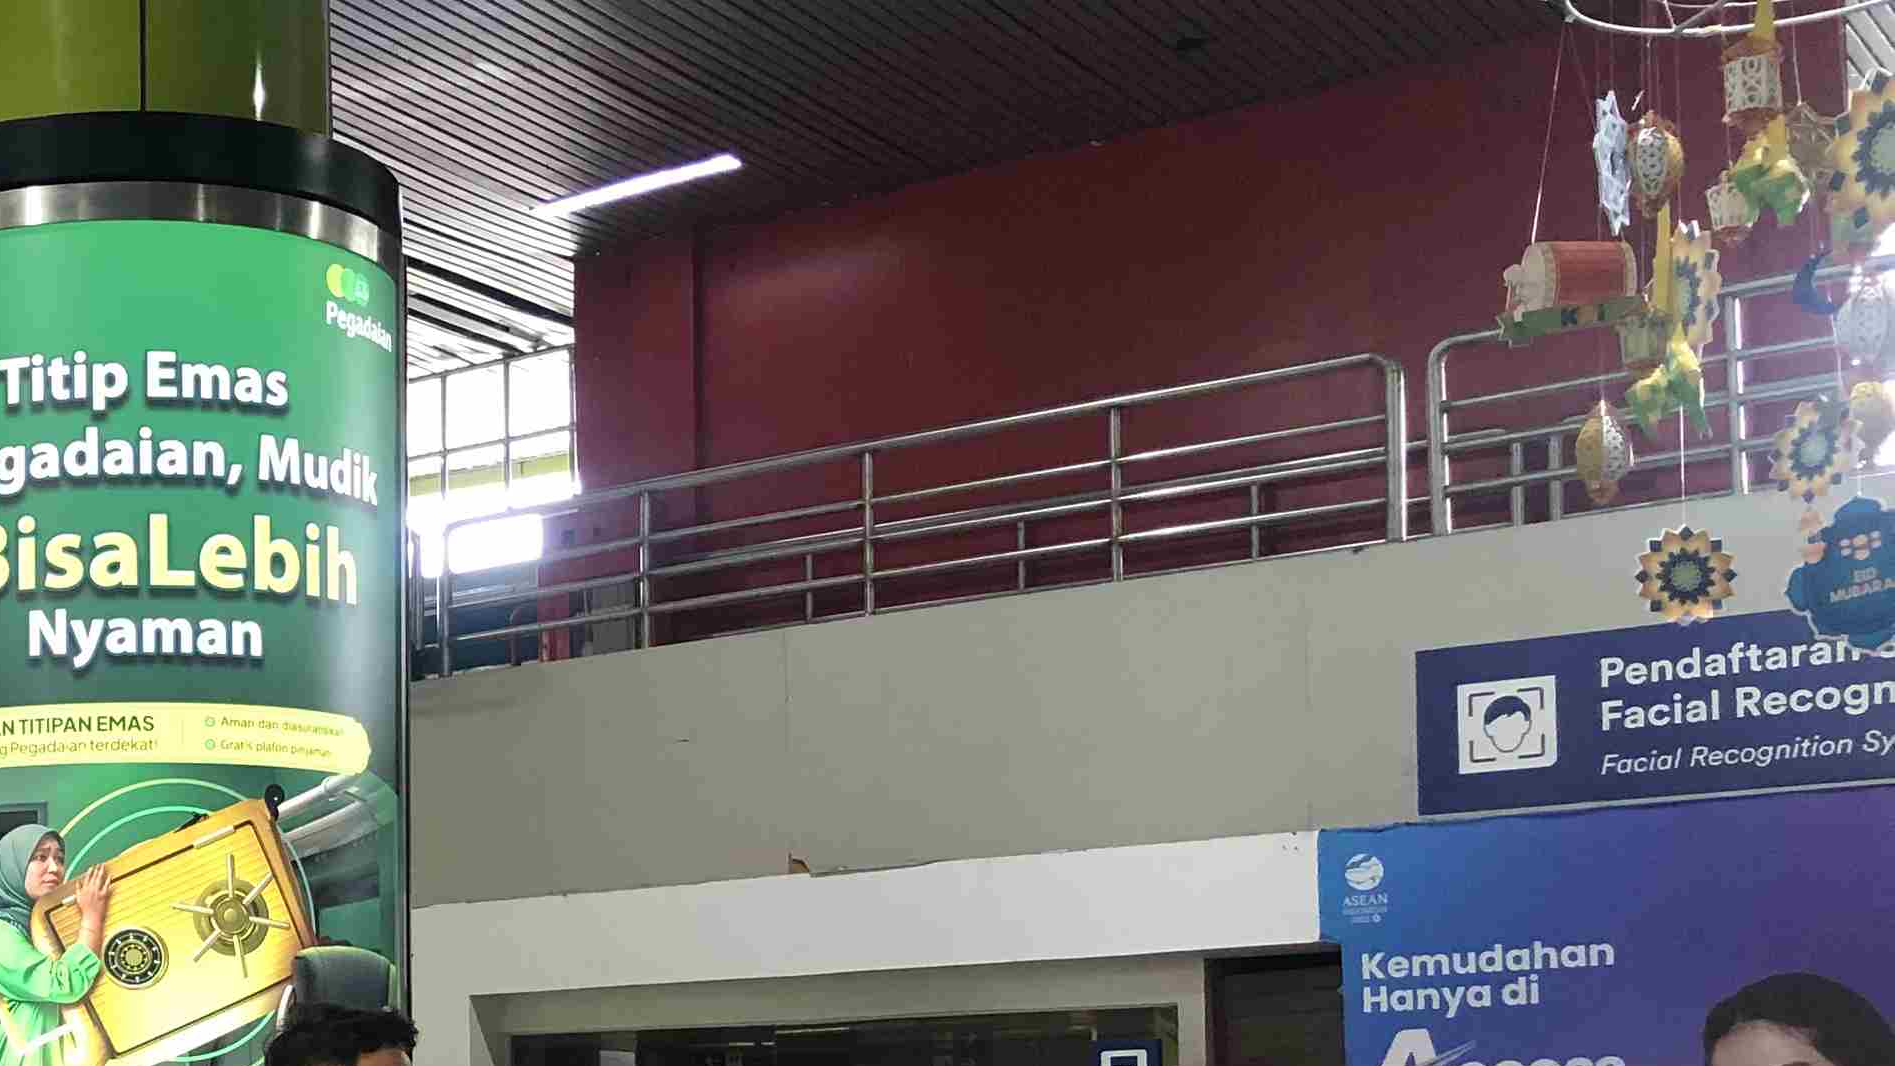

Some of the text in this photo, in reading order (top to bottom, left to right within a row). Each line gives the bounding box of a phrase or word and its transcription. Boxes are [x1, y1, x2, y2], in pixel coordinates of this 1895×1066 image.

[326, 299, 392, 352] Pegadaian
[146, 350, 289, 407] Emas
[258, 433, 378, 506] Mudik
[27, 608, 263, 668] Nyaman
[1599, 641, 1862, 689] Pendaftaran
[19, 715, 92, 735] TITIPAN
[97, 714, 155, 732] EMAS
[220, 716, 255, 729] Aman
[258, 719, 279, 730] dan
[1601, 689, 1720, 731] Facial
[10, 740, 87, 757] Pegadaian
[1601, 747, 1682, 776] Facial
[1690, 734, 1854, 768] Recognition
[1343, 893, 1388, 906] ASEAN
[1361, 940, 1615, 980] Kemudahan
[1362, 973, 1540, 1019] Hanya di
